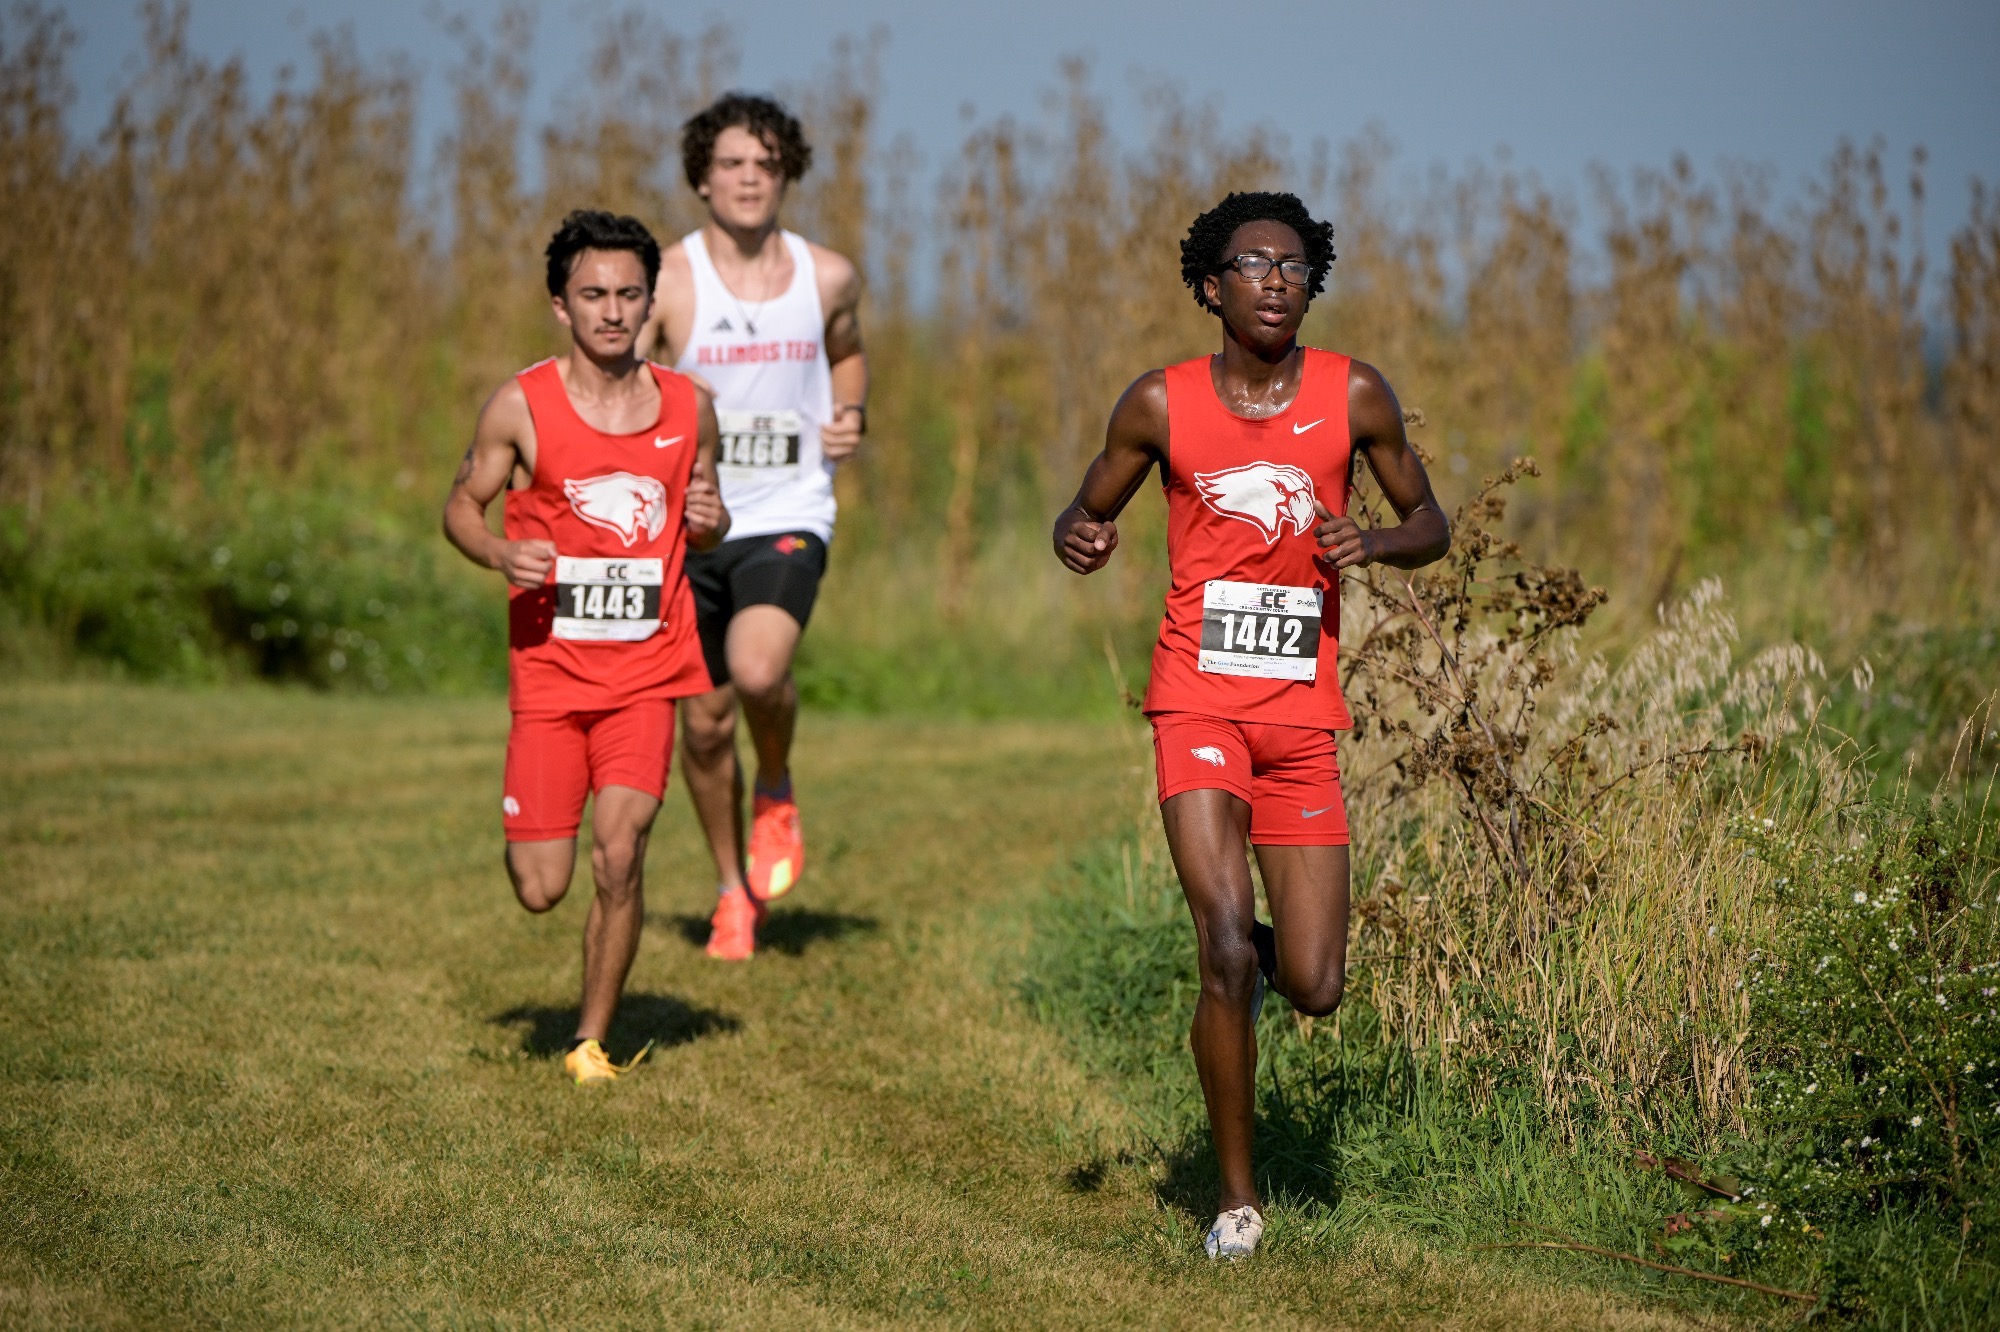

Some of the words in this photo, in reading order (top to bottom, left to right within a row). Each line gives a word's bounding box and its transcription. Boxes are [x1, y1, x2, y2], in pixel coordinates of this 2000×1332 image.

[697, 342, 781, 365] ILLINOIS
[720, 432, 790, 467] 1468
[606, 566, 628, 579] CC
[570, 585, 646, 619] 1443
[1260, 591, 1287, 610] CC
[1221, 613, 1303, 655] 1442
